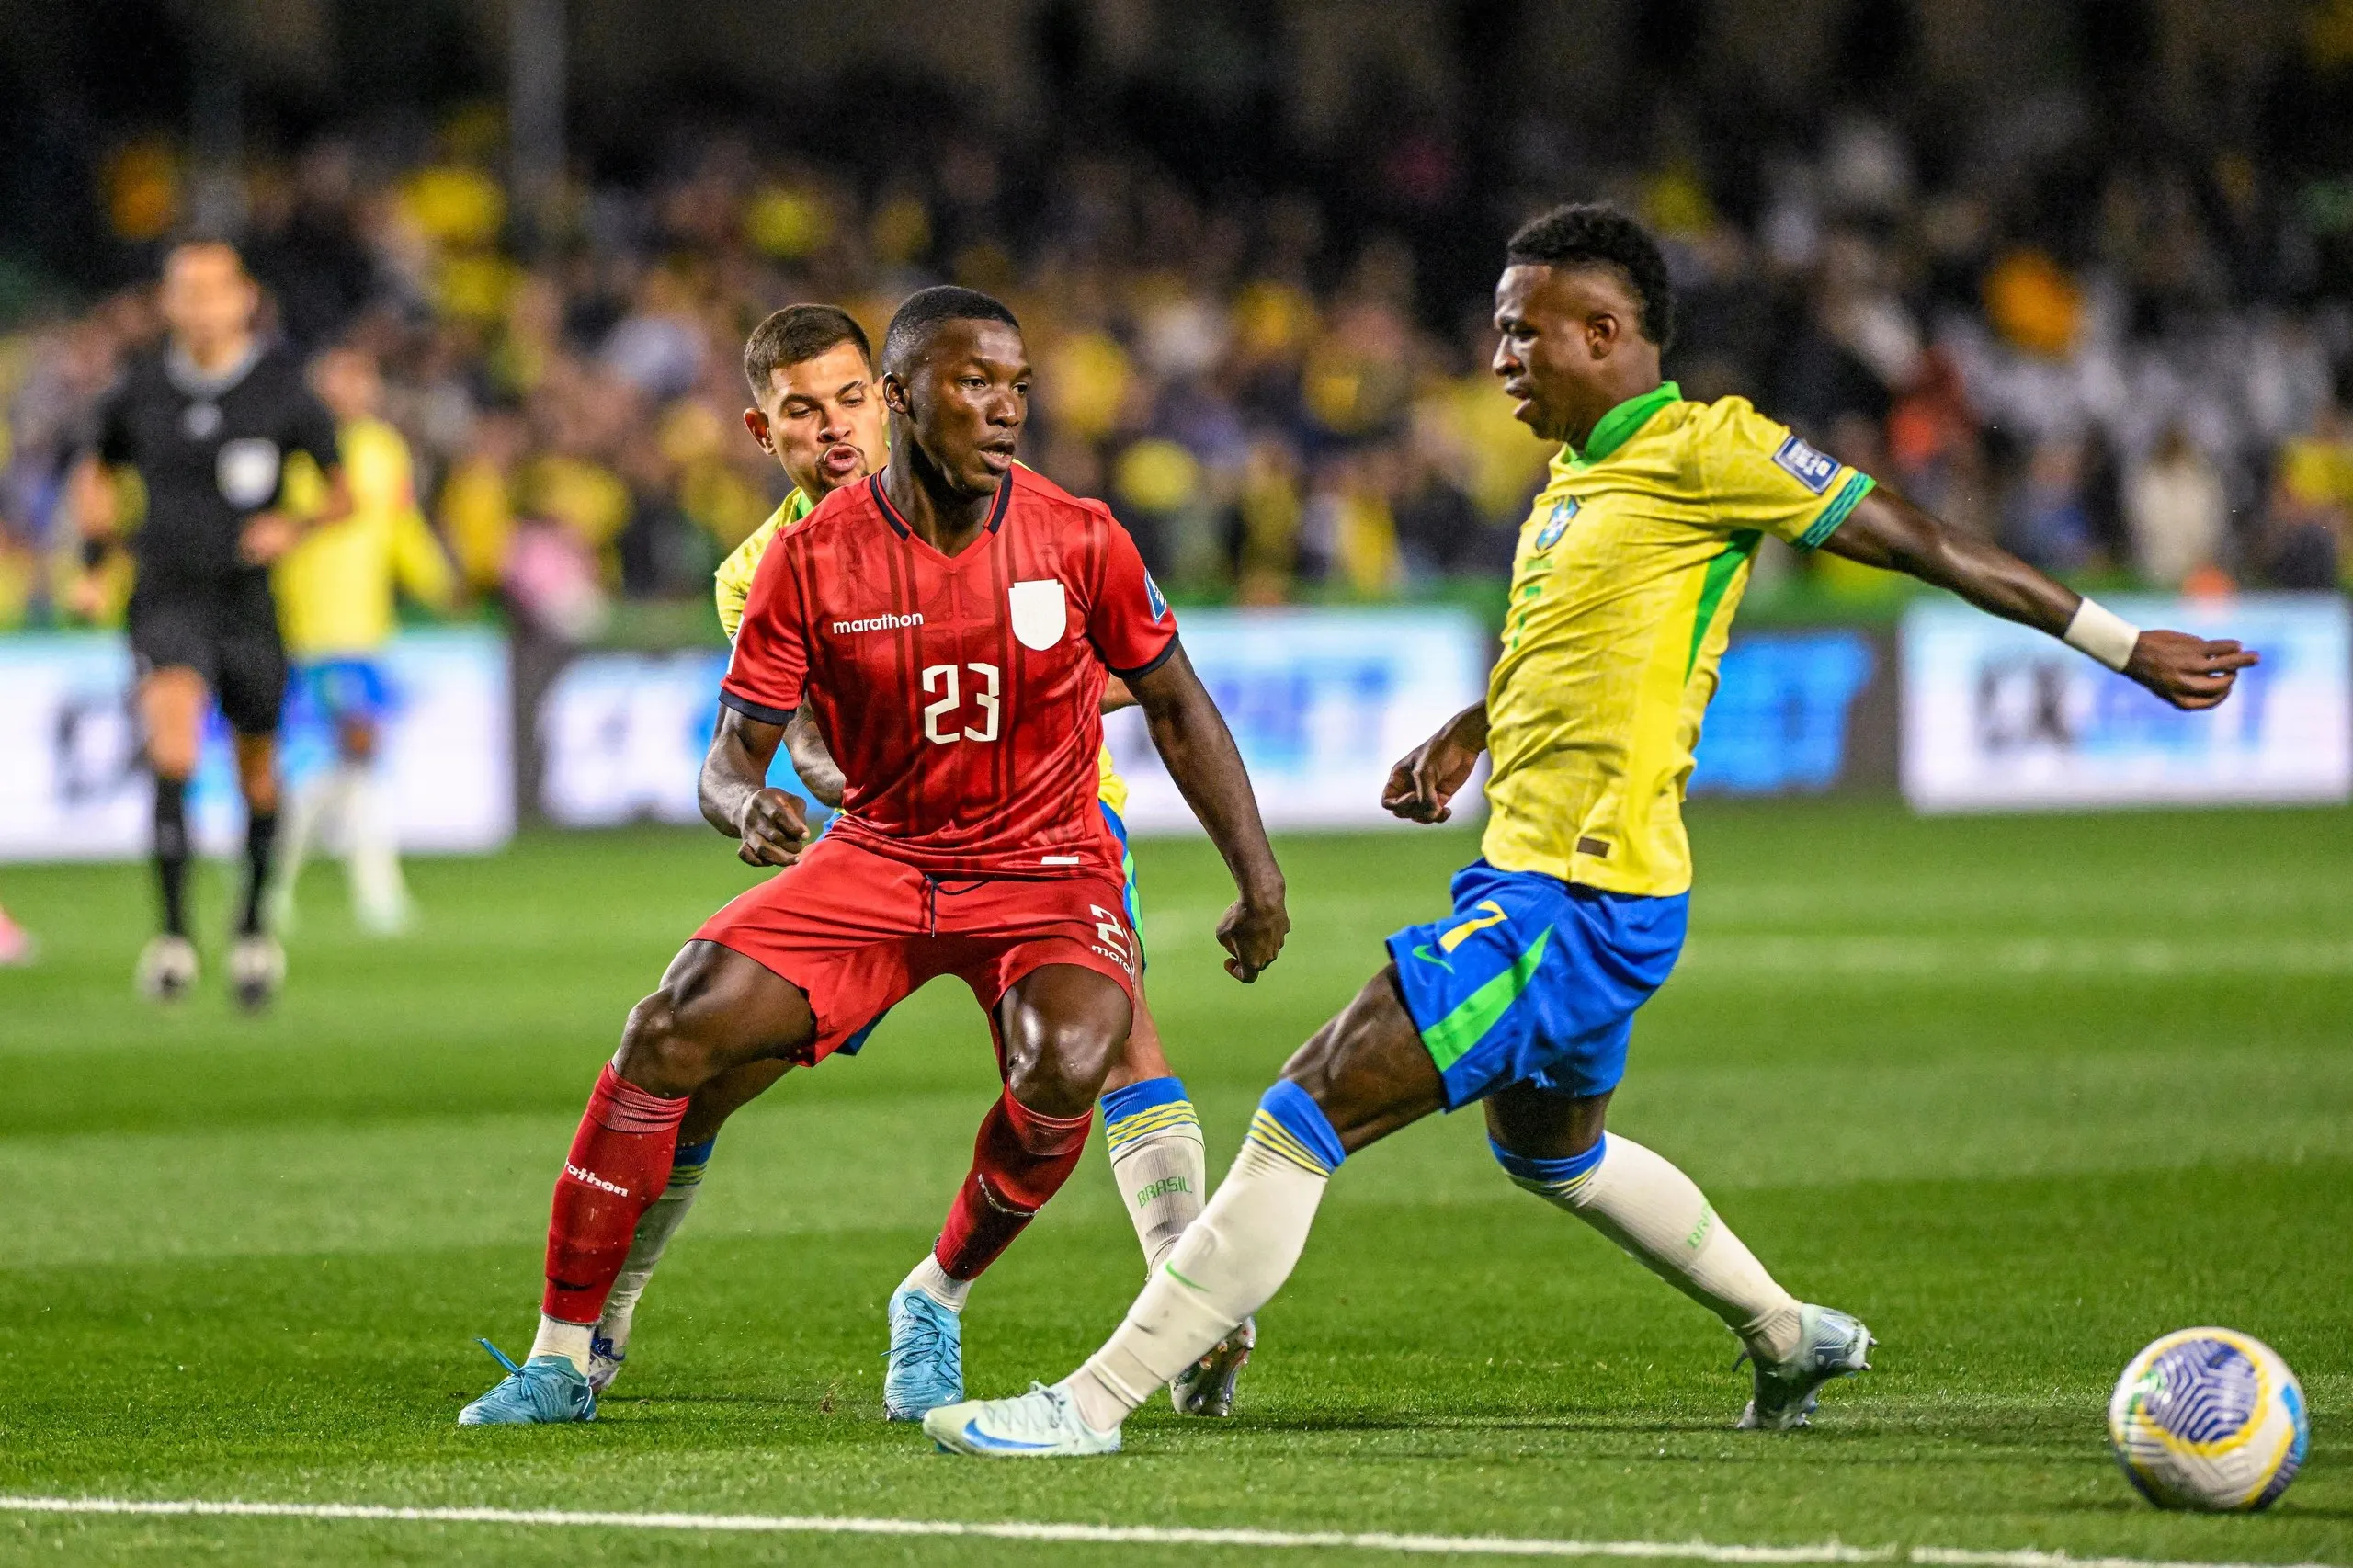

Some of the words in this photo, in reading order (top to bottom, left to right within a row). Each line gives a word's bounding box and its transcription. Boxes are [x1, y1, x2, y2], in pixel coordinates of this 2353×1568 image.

[833, 611, 924, 635] marathon
[922, 662, 1000, 744] 23
[1089, 903, 1135, 960] 2
[1439, 899, 1508, 954] 7
[1136, 1176, 1193, 1209] BRASIL
